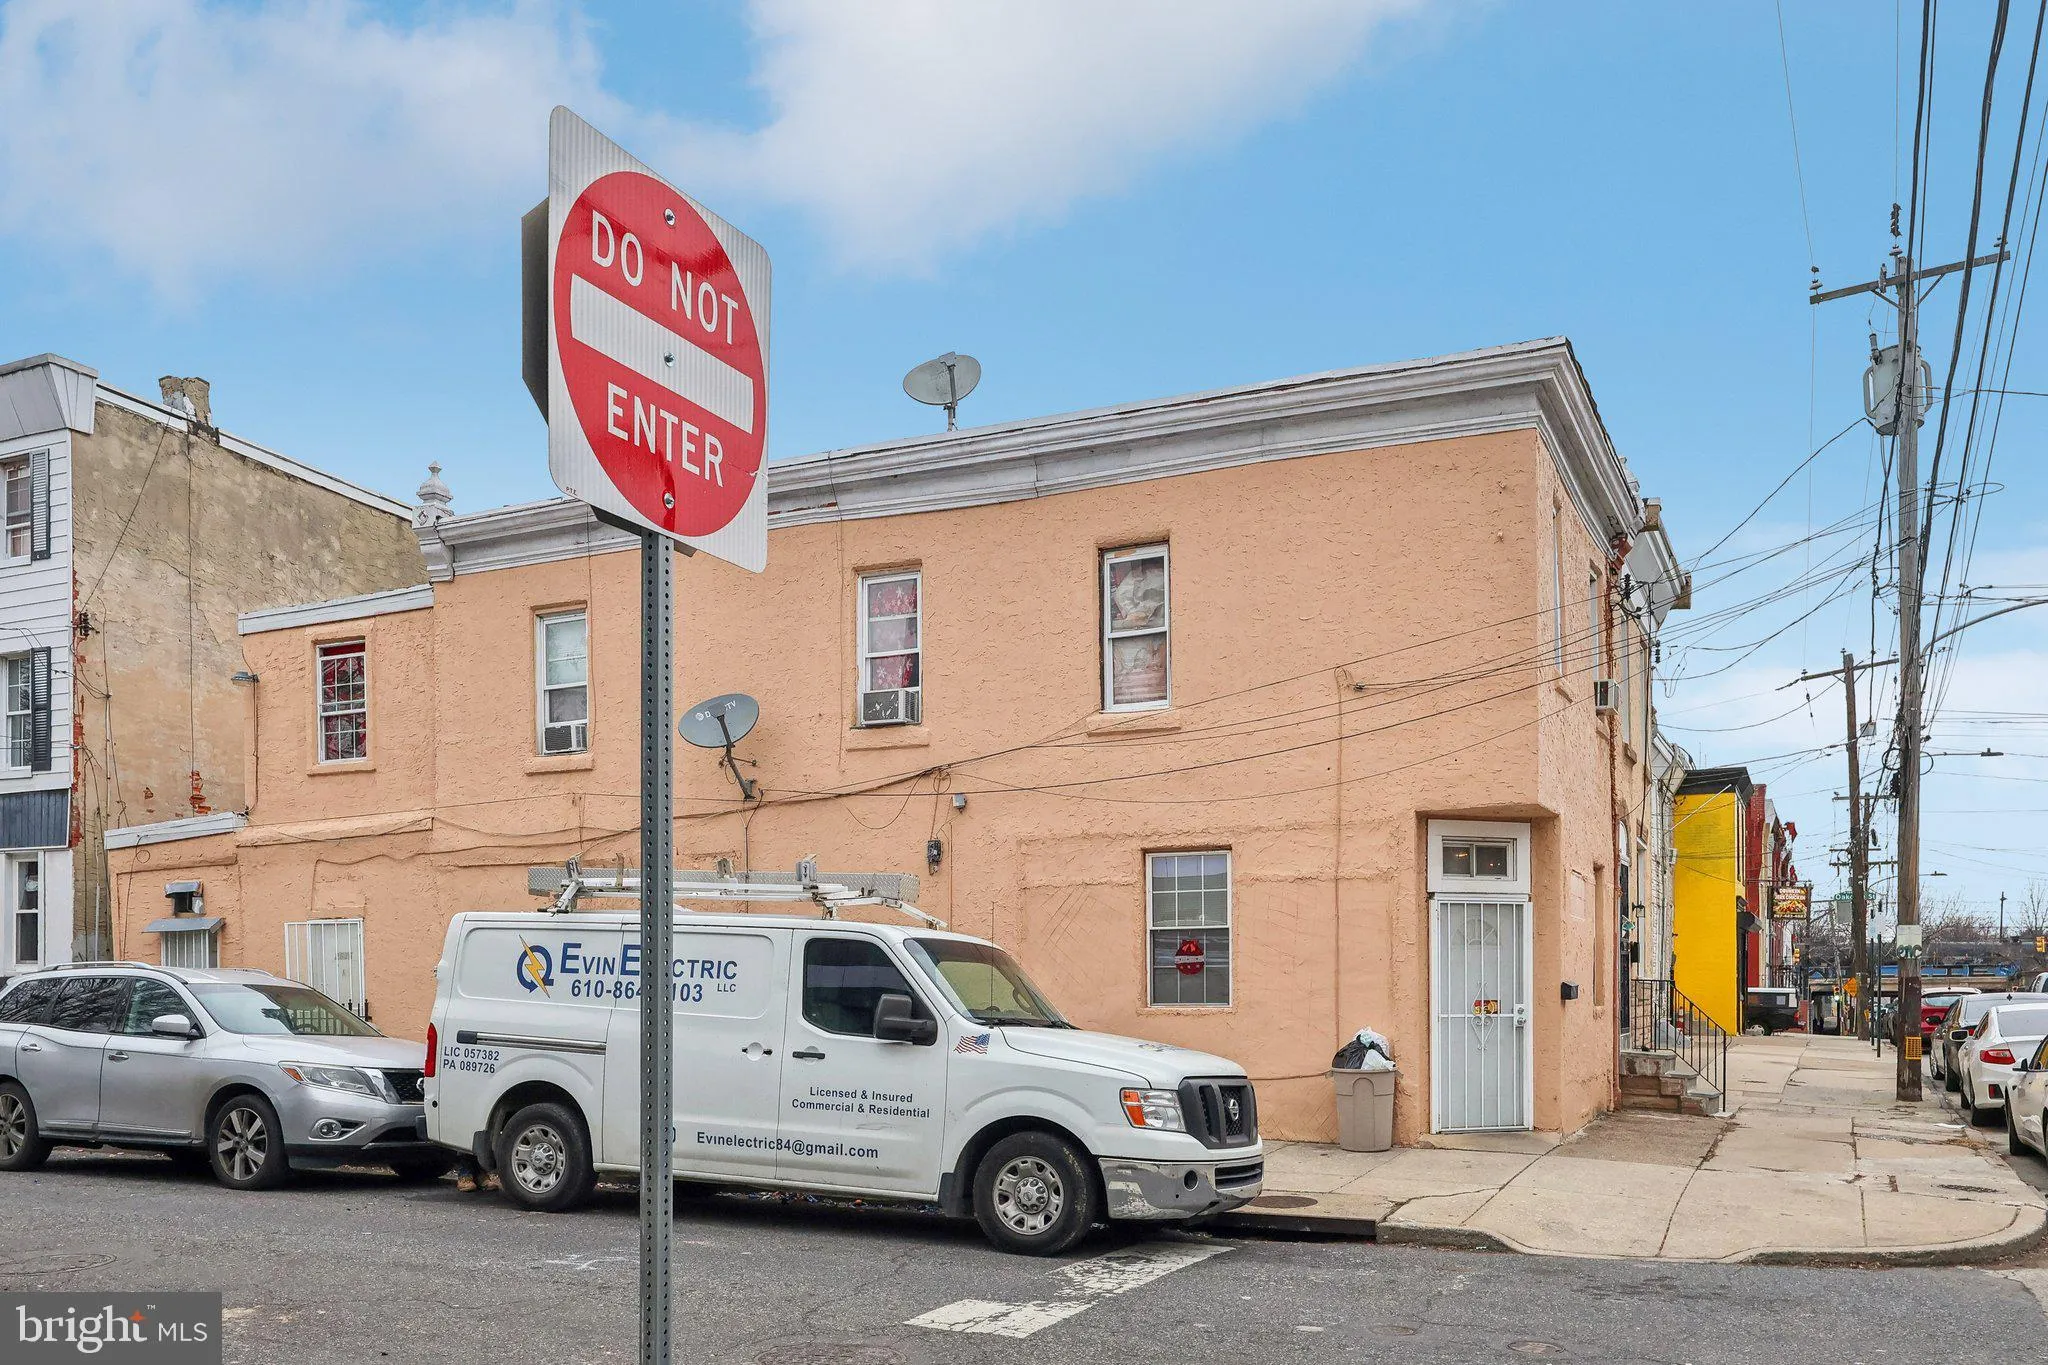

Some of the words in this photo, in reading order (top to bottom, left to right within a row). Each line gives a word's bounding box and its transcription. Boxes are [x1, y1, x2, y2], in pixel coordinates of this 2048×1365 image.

[592, 209, 644, 287] DO
[671, 261, 738, 345] NOT
[607, 381, 723, 487] ENTER
[620, 944, 738, 979] ECTRIC
[571, 979, 703, 1002] 610-86103
[717, 983, 737, 993] LLC
[444, 1046, 460, 1057] LIC
[464, 1048, 500, 1061] 057382
[443, 1059, 456, 1070] PA
[460, 1060, 495, 1073] 089726
[809, 1086, 857, 1099] Licensed
[860, 1089, 868, 1100] &
[872, 1091, 913, 1103] Insured
[792, 1098, 854, 1113] Commercial
[857, 1103, 865, 1113] &
[869, 1104, 930, 1118] Residential
[697, 1131, 878, 1159] Evinelectric84@gmail.com
